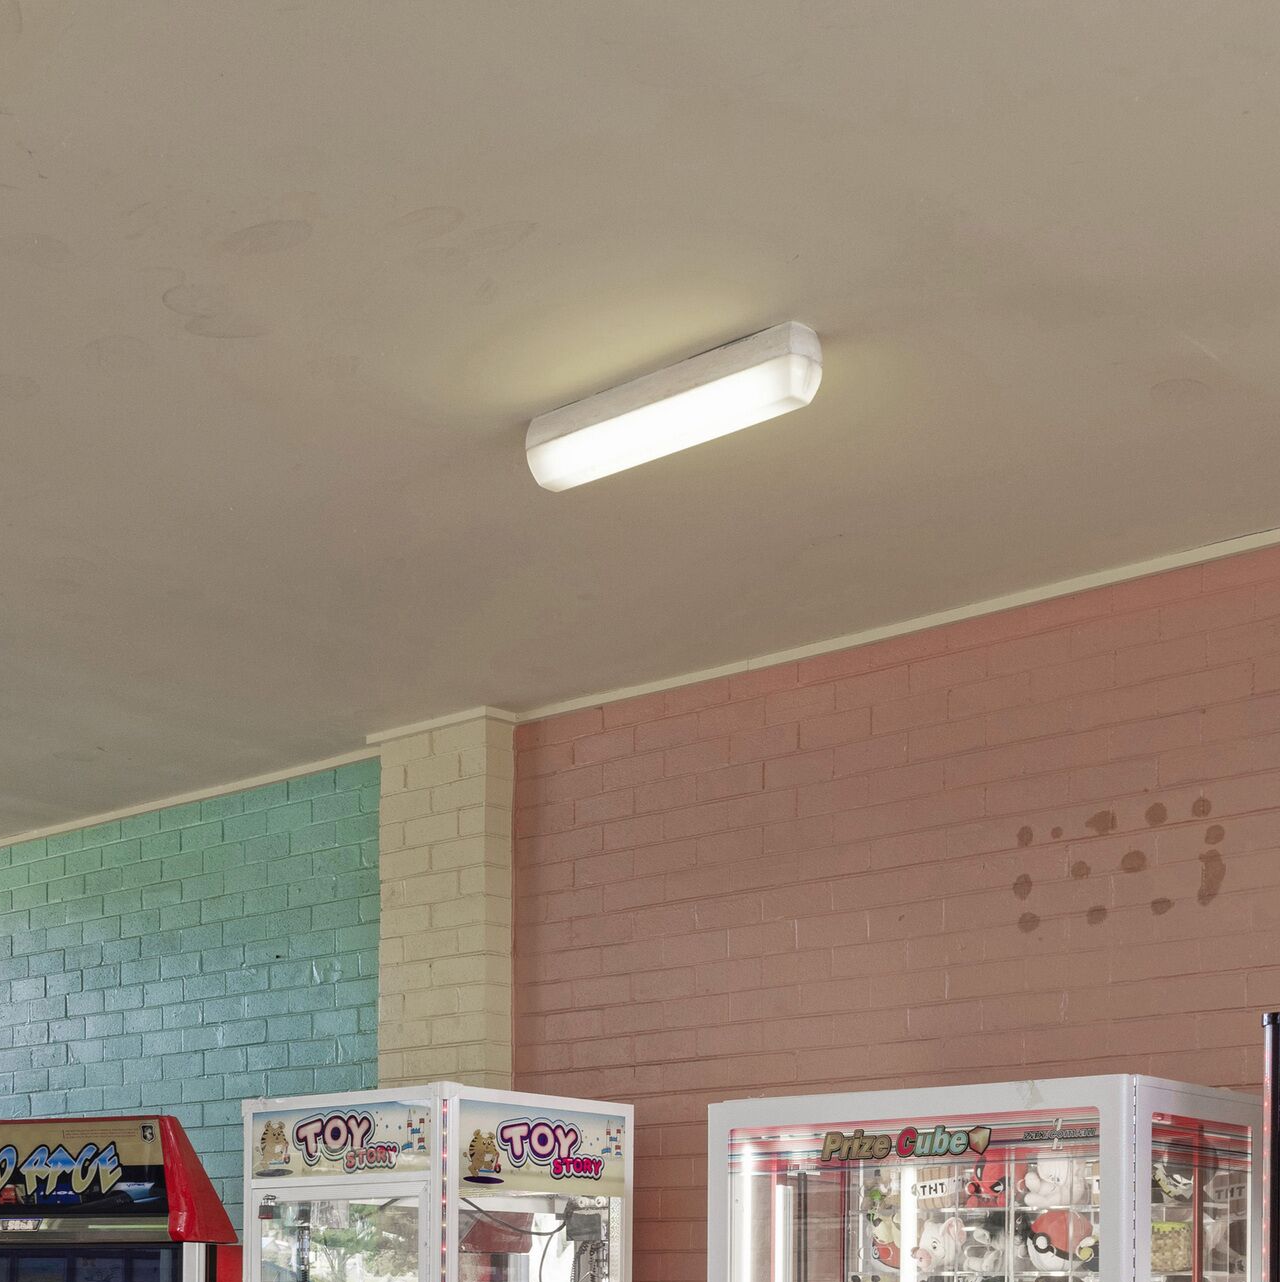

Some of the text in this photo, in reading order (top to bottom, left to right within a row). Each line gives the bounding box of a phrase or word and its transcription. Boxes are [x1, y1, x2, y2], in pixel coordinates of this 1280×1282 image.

[297, 1113, 399, 1170] TOY STORY
[501, 1121, 602, 1179] TOY STORY
[820, 1125, 970, 1161] Prize Cube
[920, 1183, 946, 1197] TNT
[1215, 1186, 1246, 1200] TNT
